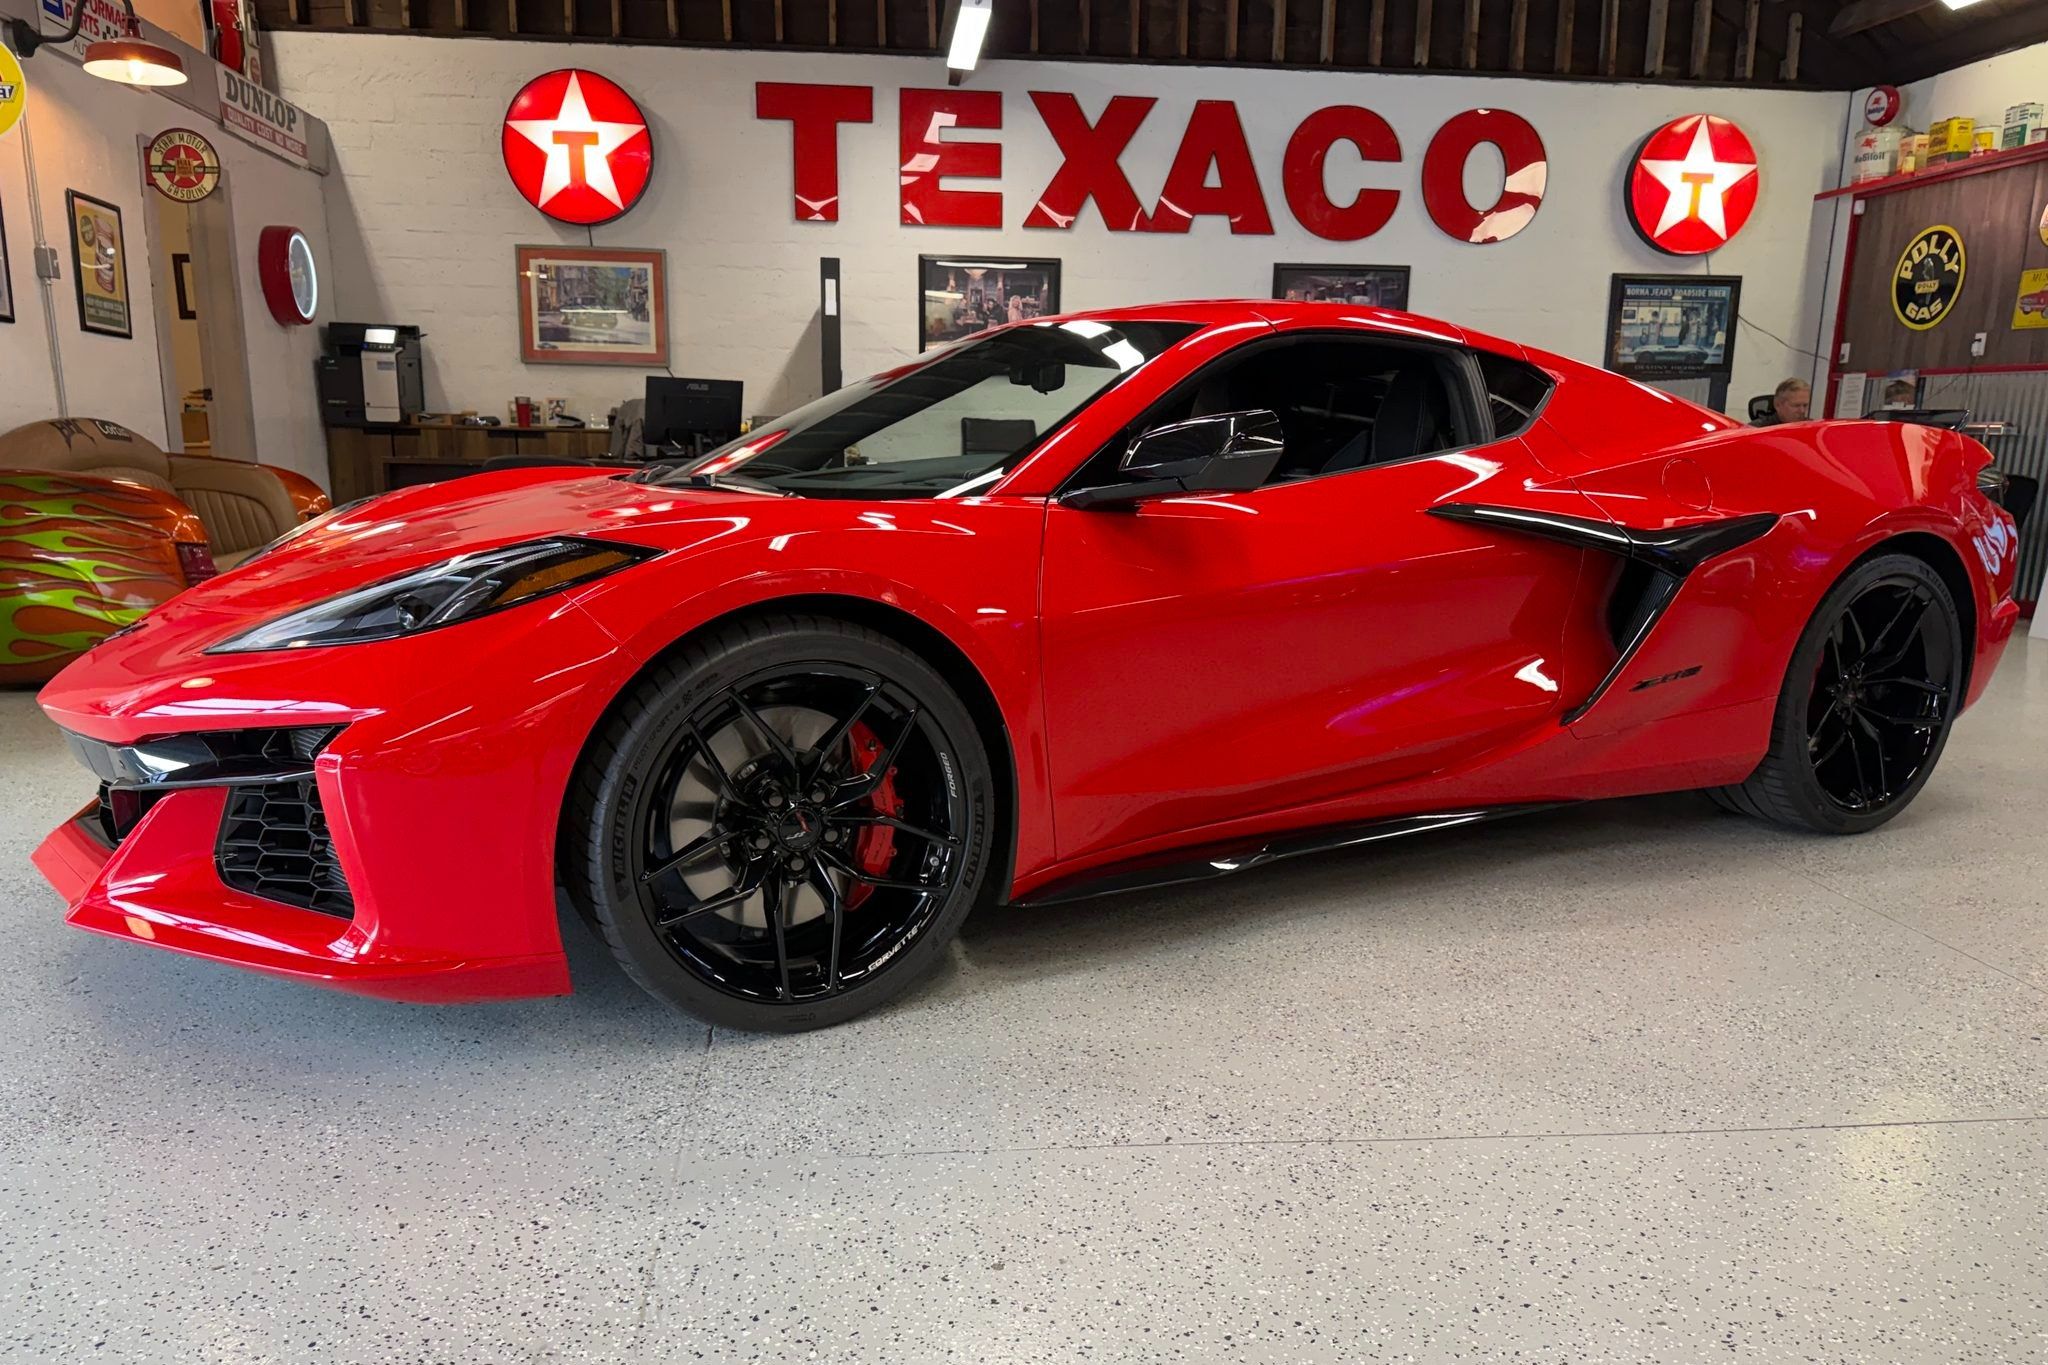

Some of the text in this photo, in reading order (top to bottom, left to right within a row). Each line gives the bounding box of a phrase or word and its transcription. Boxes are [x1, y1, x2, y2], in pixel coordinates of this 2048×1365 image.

[64, 2, 100, 37] PRTS
[224, 70, 297, 133] DUNLOP
[154, 133, 208, 156] STAR MOTOR
[552, 130, 599, 191] T
[756, 82, 1547, 244] TEXACO
[166, 183, 209, 200] GASOLINE
[1681, 172, 1713, 220] T
[1899, 234, 1959, 280] POLLY
[1626, 287, 1649, 296] NORMA
[1674, 288, 1706, 297] ROADSIDE
[1707, 288, 1727, 297] DINER
[1905, 298, 1943, 320] GAS
[686, 383, 709, 391] ASUS
[940, 752, 958, 798] FORGED
[613, 780, 635, 877] MICHELIN
[964, 800, 985, 888] MICHELIN
[868, 924, 920, 972] CORVETTE
